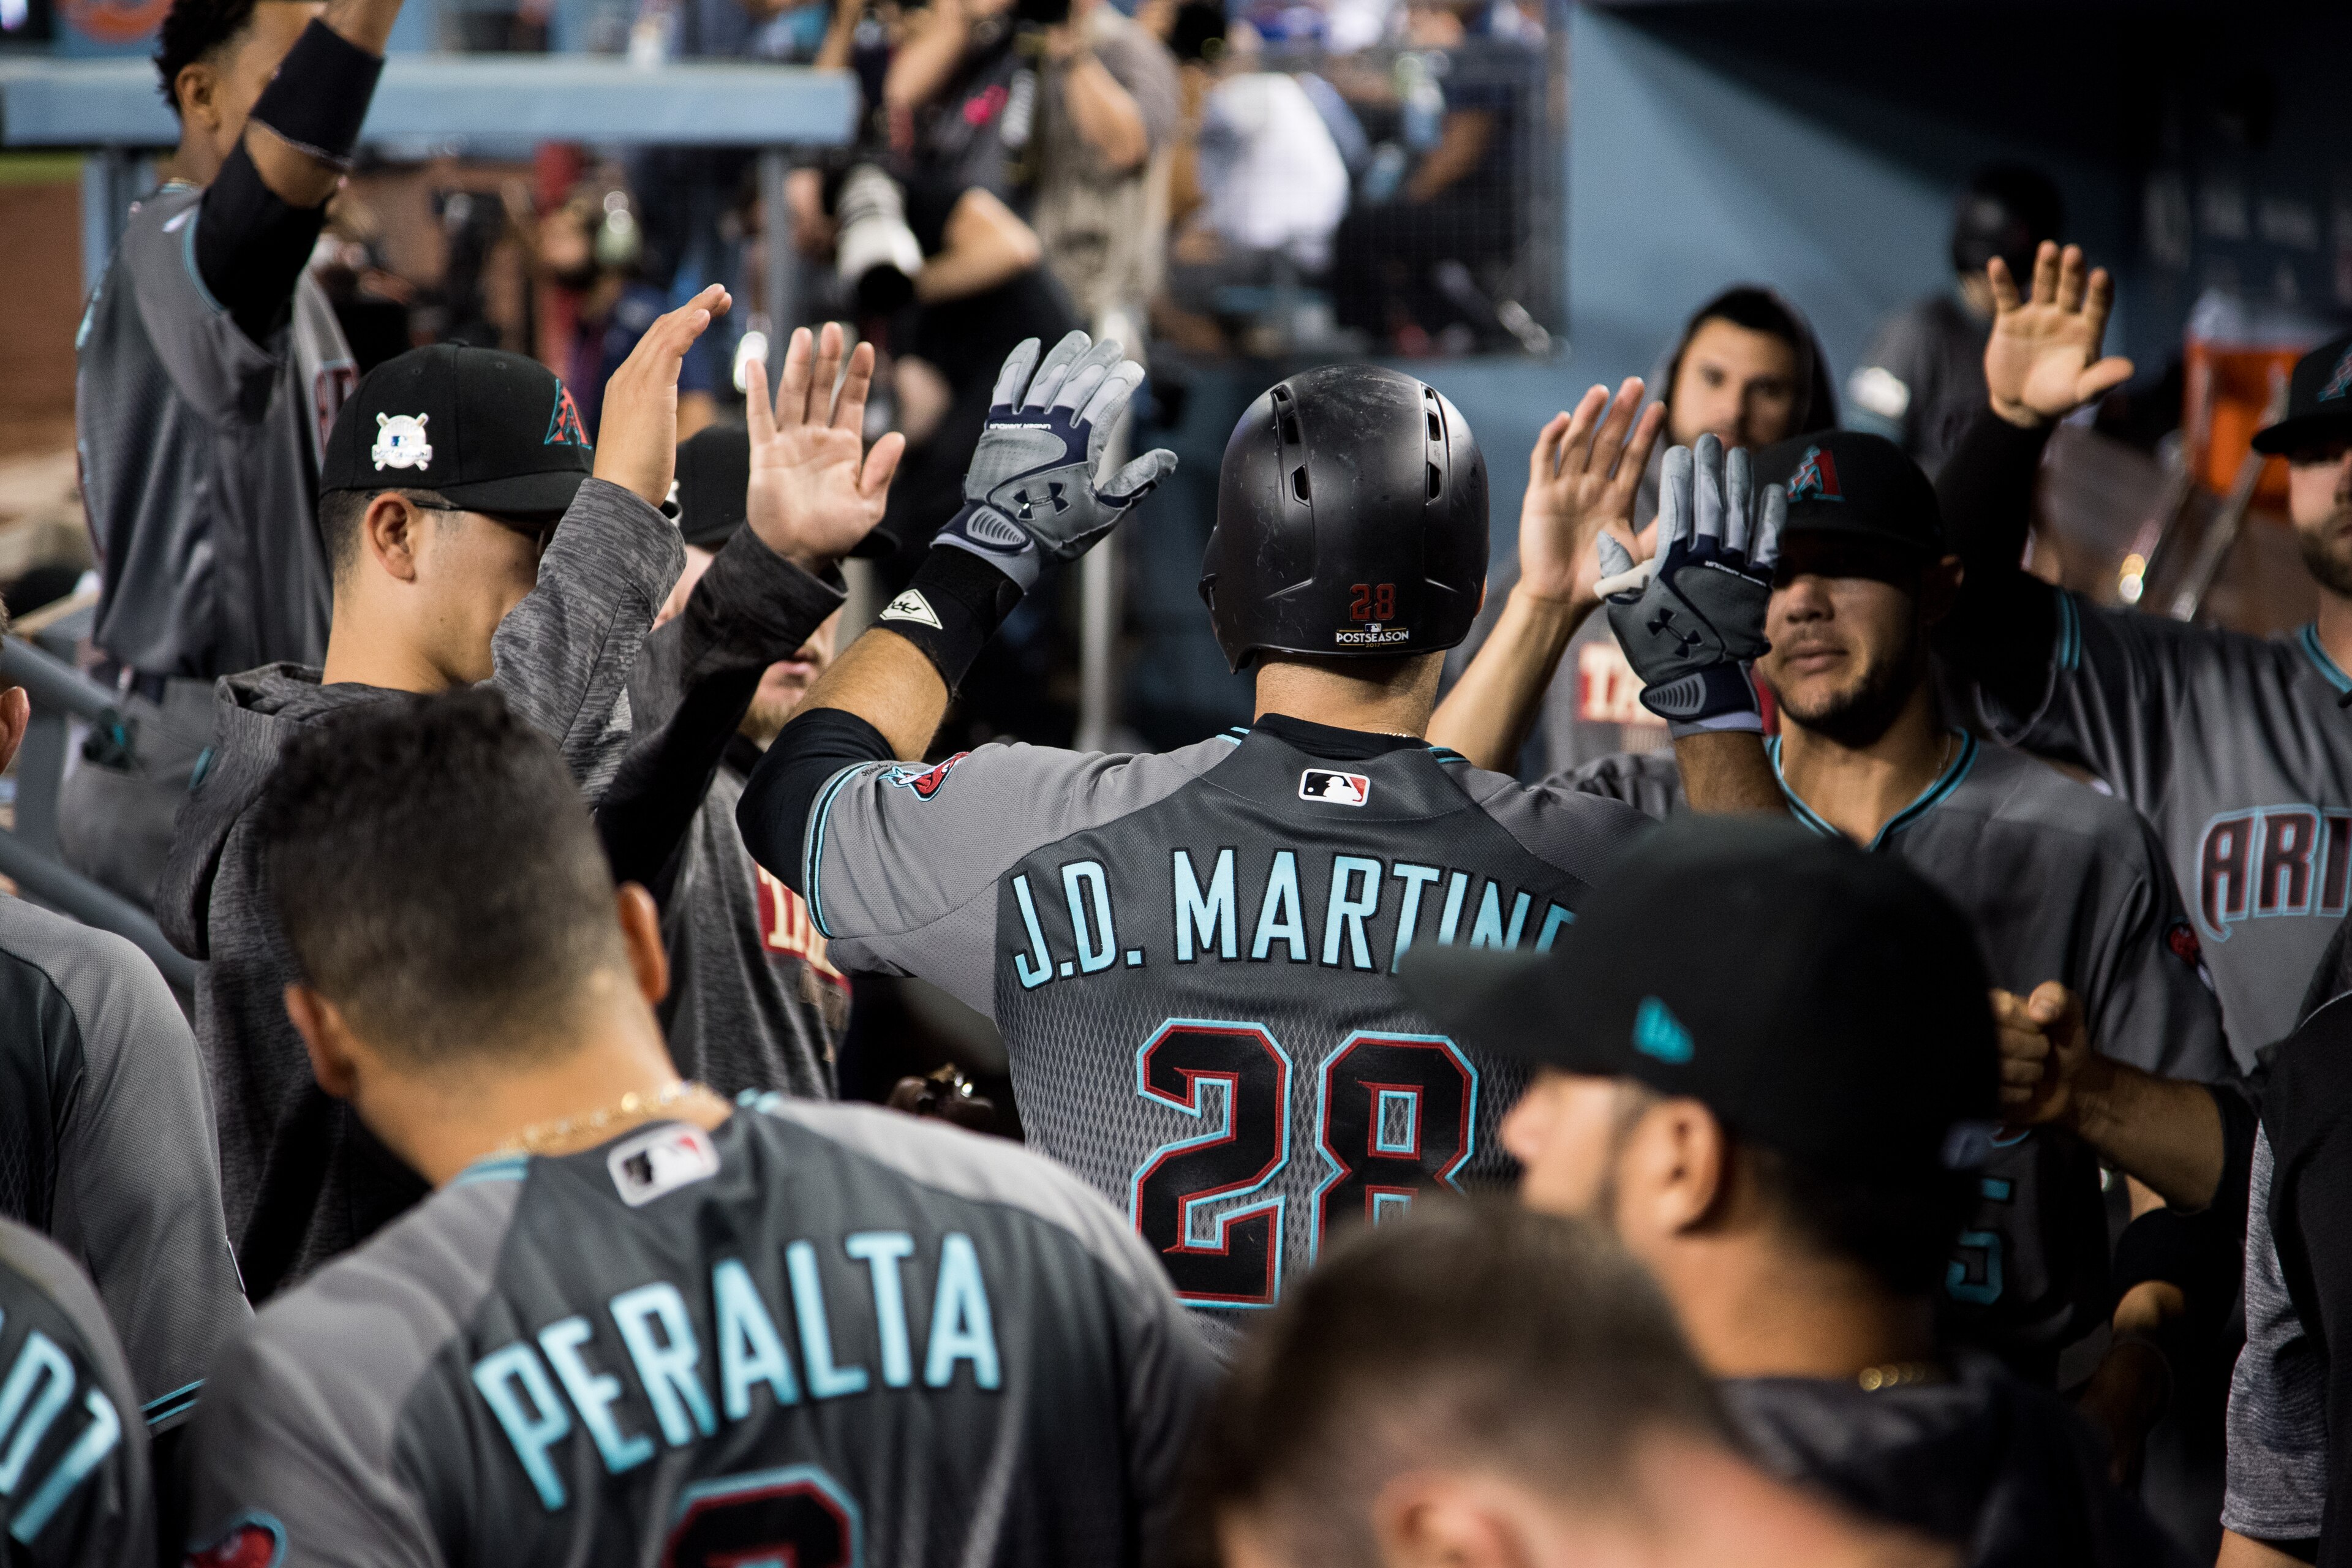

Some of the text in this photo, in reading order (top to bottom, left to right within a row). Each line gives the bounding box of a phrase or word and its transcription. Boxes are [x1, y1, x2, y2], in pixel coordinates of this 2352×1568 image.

[1336, 630, 1409, 643] POSTSEASON
[1349, 583, 1396, 621] 28
[1011, 859, 1147, 991] J.D.
[1129, 1017, 1479, 1310] 28
[472, 1231, 1001, 1512] PERALTA
